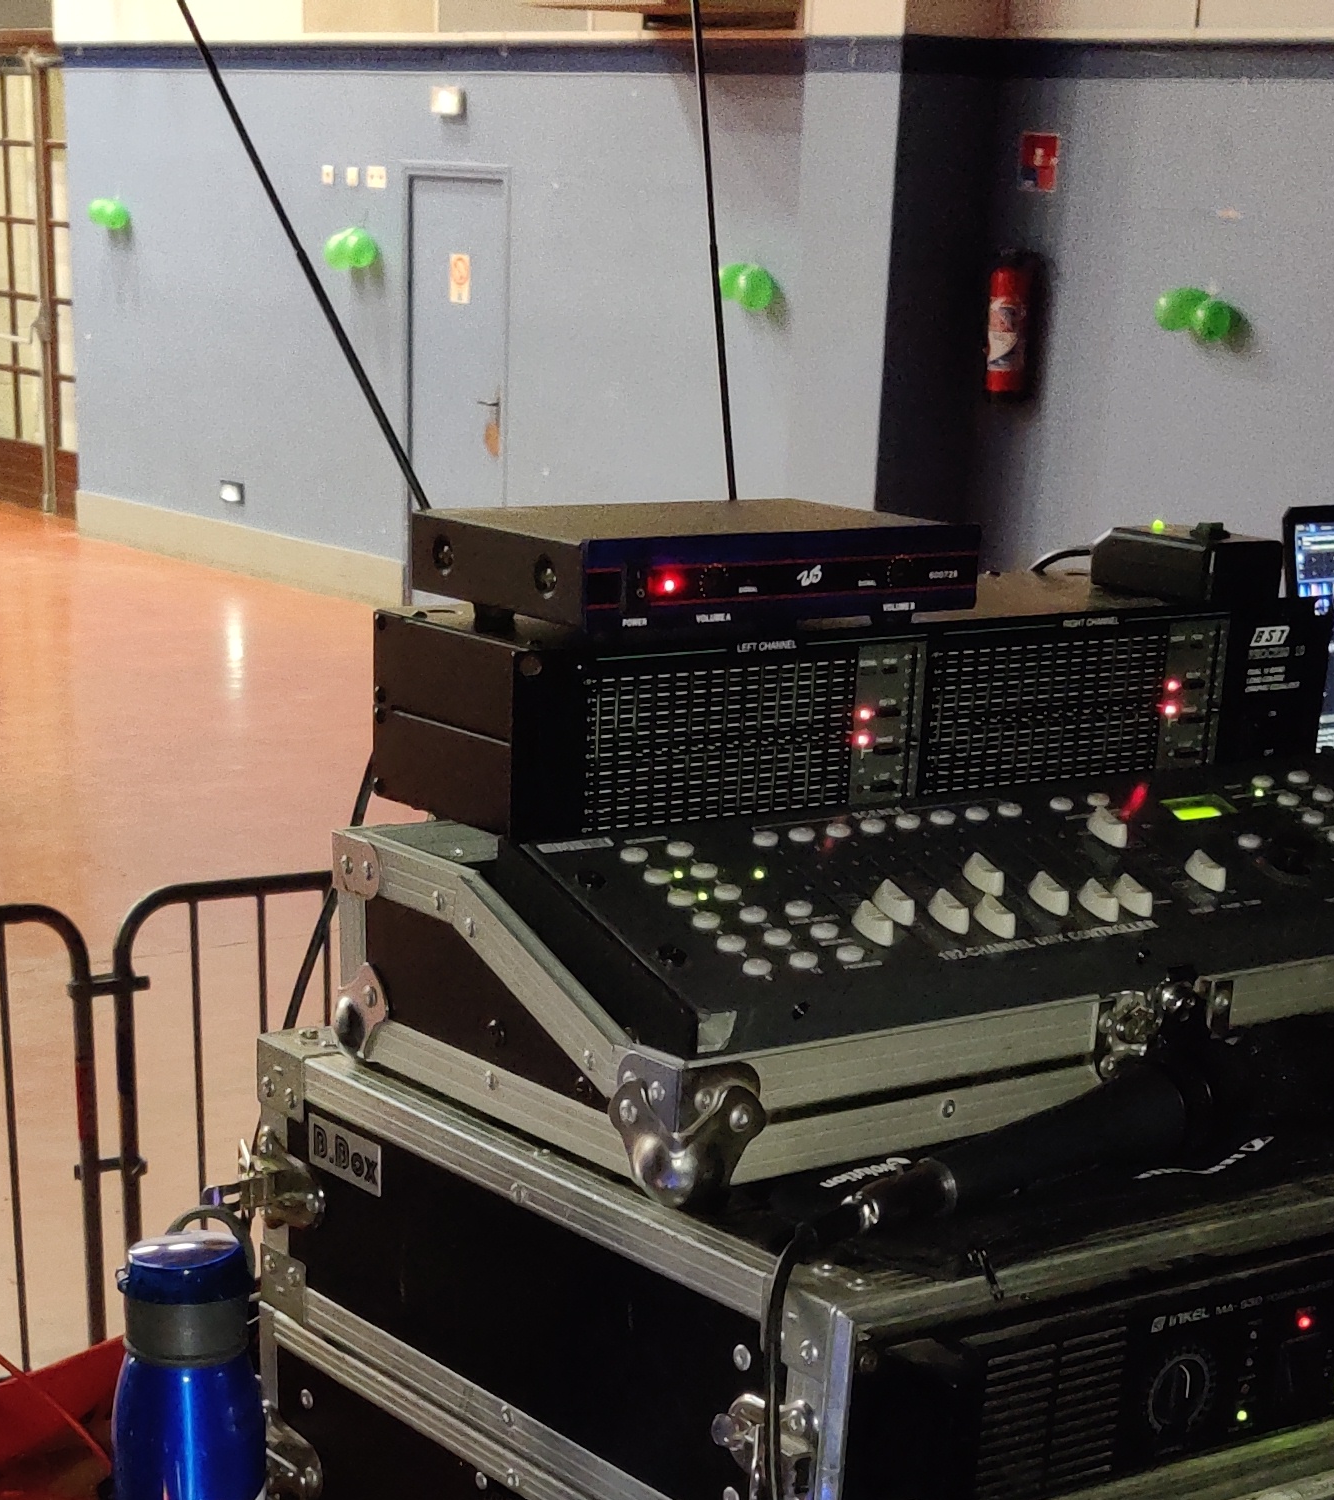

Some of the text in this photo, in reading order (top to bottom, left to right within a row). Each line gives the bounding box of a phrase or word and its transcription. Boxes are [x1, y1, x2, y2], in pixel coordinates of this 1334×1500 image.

[1253, 629, 1286, 643] BST
[737, 640, 797, 653] LEFT CHANNEL
